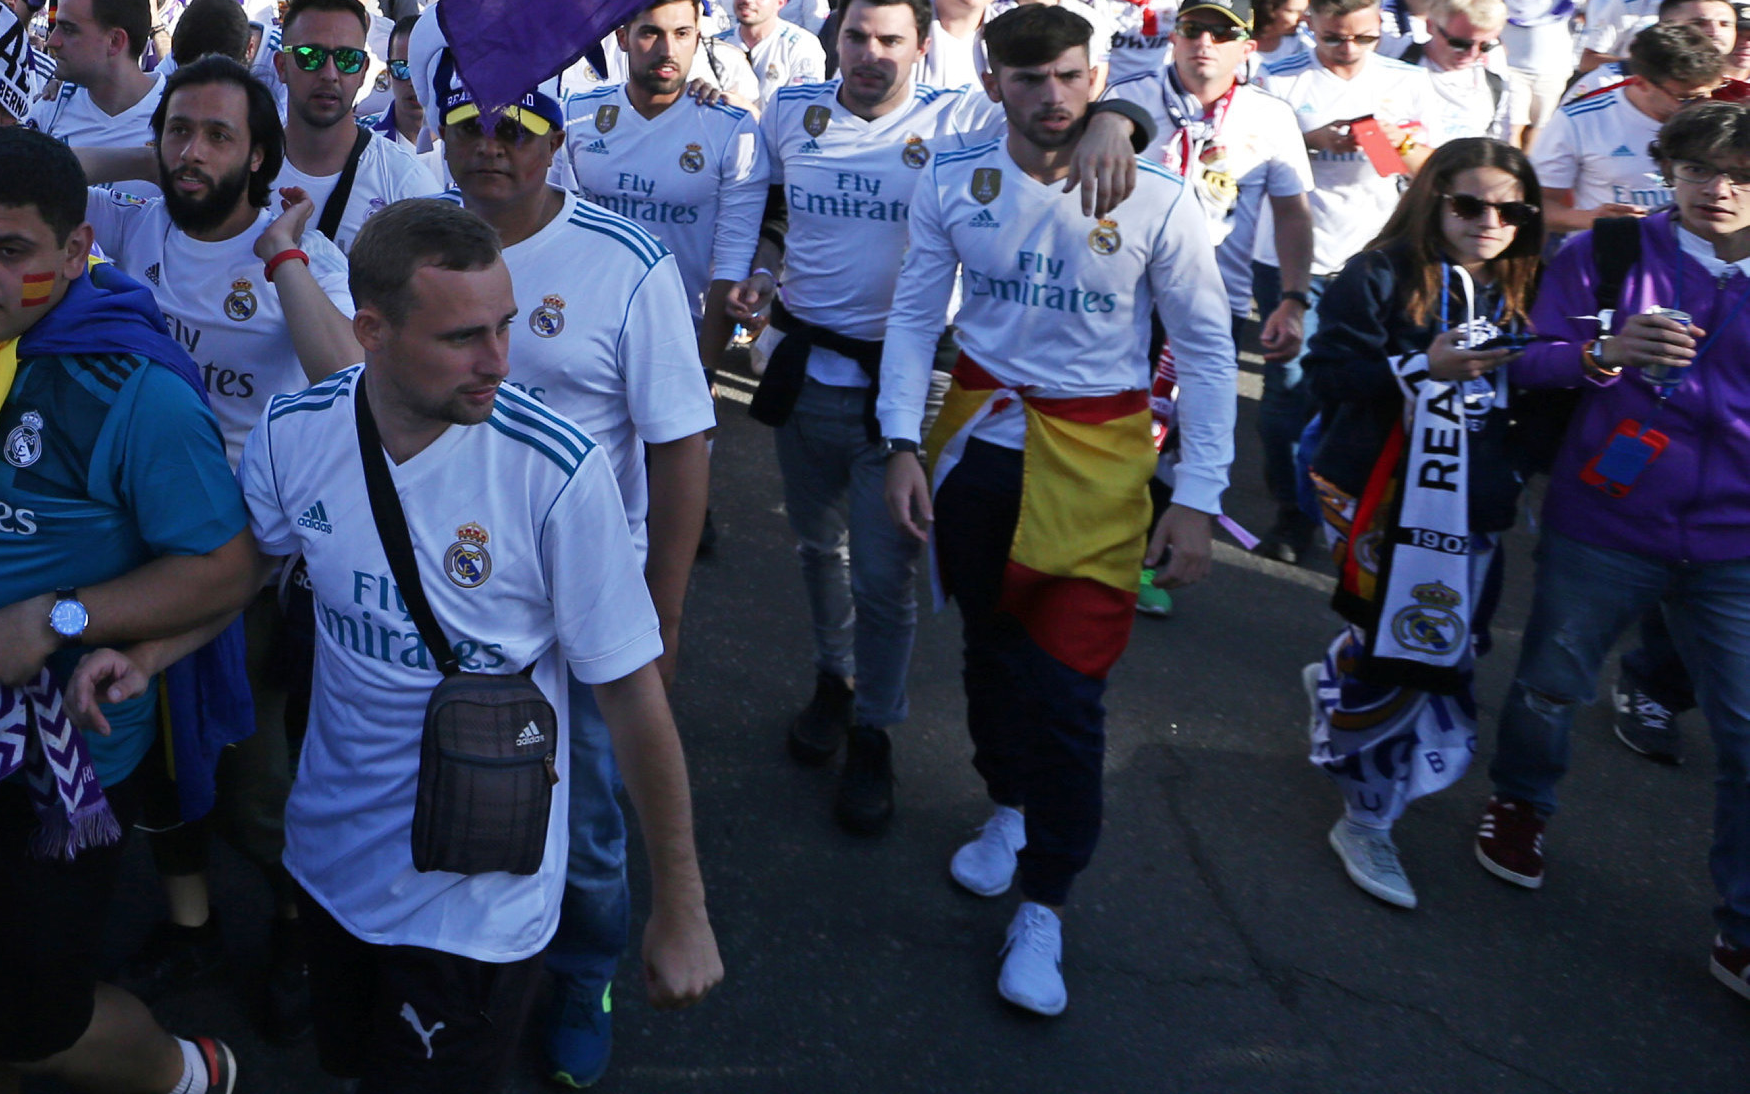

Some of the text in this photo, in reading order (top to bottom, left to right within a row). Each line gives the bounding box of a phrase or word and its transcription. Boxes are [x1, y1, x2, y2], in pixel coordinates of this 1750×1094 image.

[618, 172, 656, 197] Fly
[837, 172, 881, 197] Fly
[582, 184, 699, 225] mirates
[790, 184, 910, 223] Emirat
[1018, 251, 1065, 280] Fly
[969, 269, 1118, 315] Emirates
[1418, 382, 1462, 493] REA
[297, 516, 333, 535] adidas
[319, 600, 506, 671] miraes
[515, 733, 546, 748] adidas
